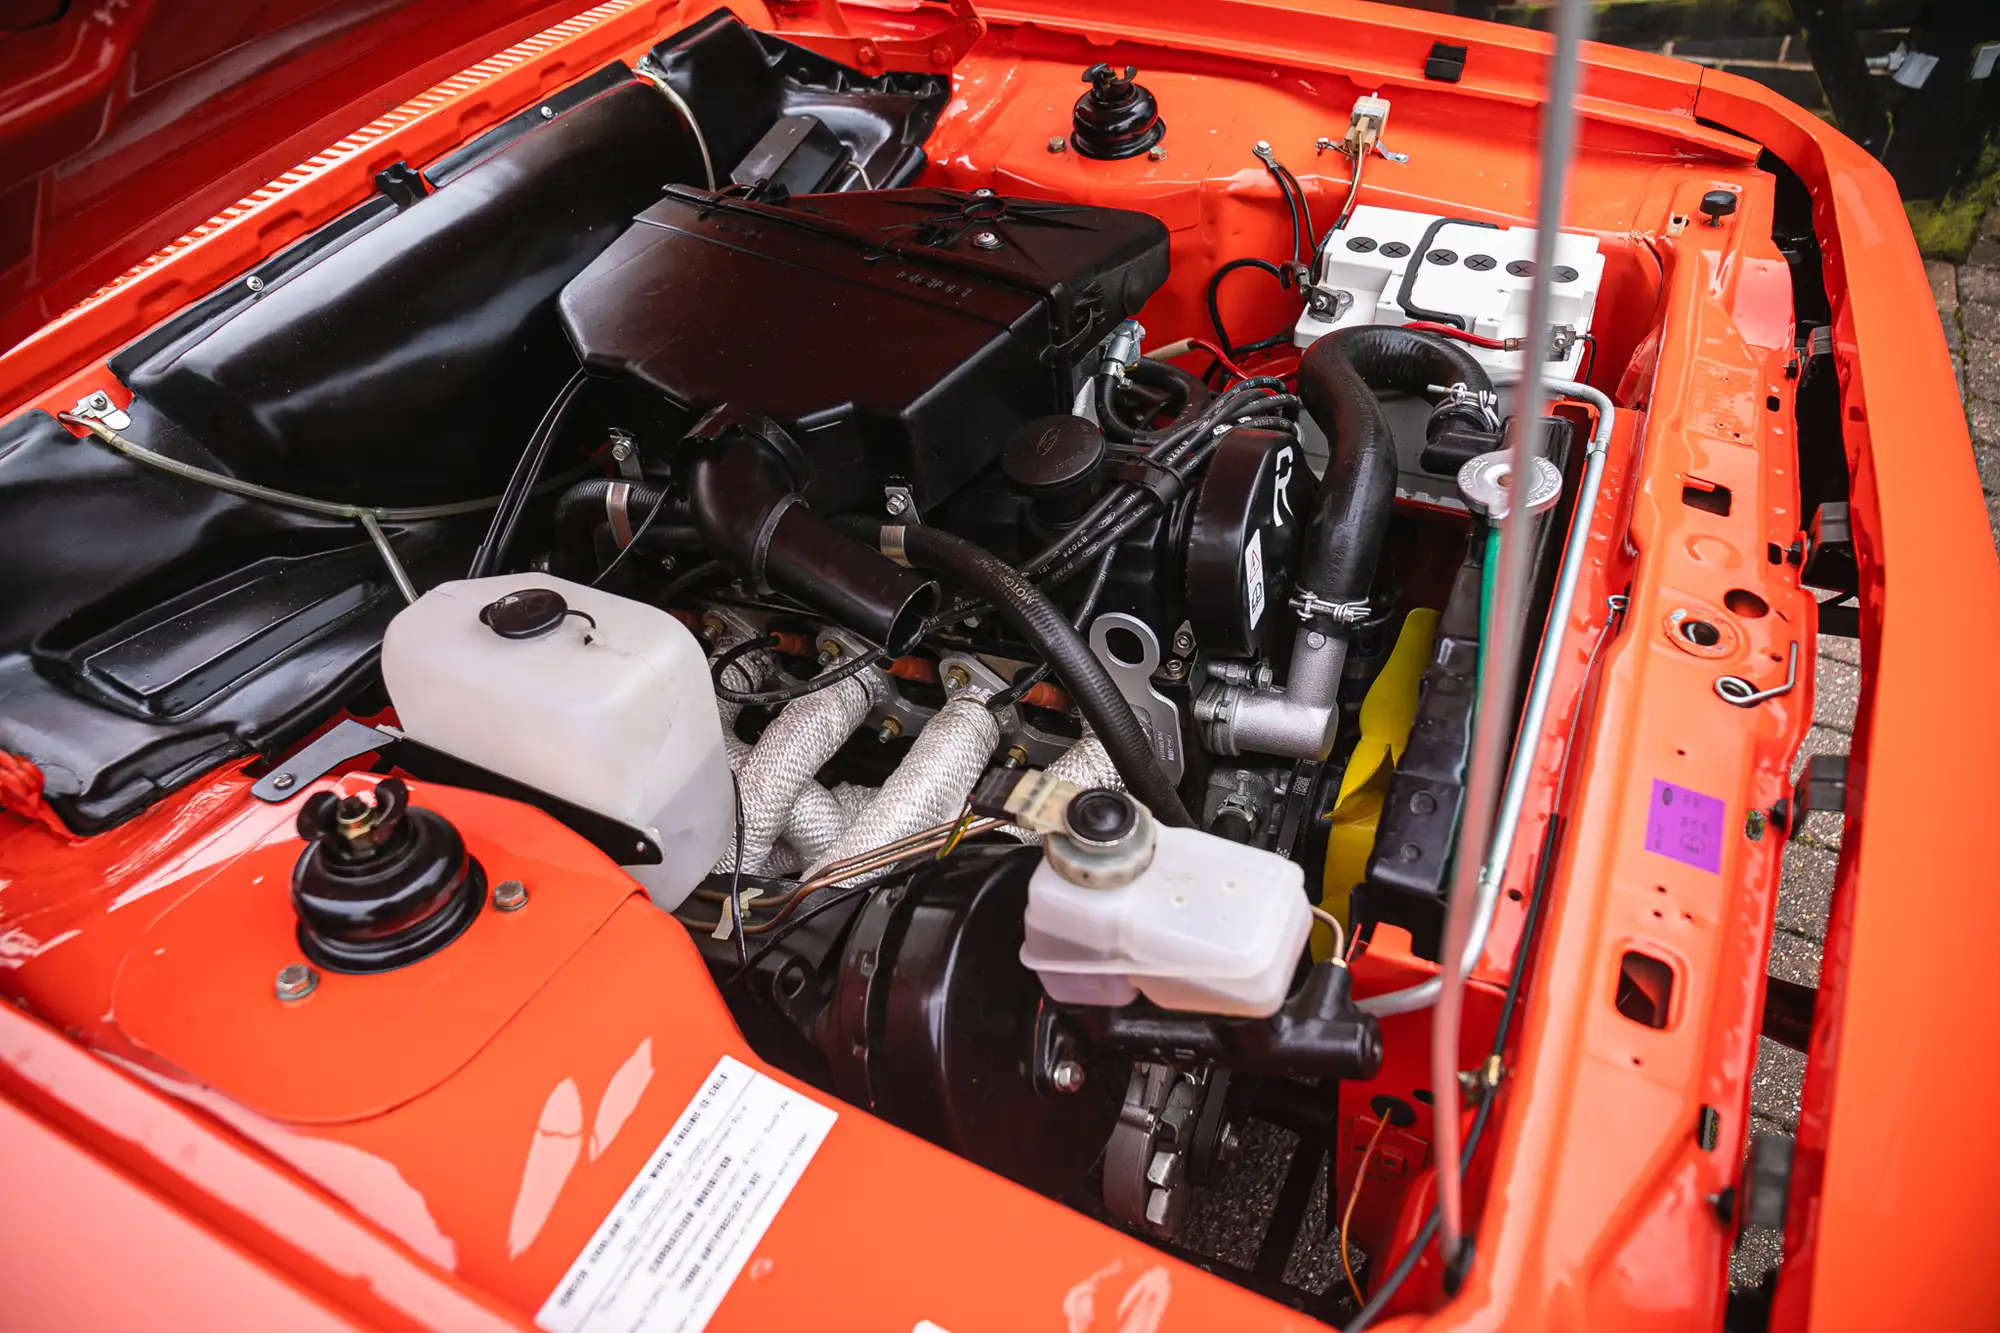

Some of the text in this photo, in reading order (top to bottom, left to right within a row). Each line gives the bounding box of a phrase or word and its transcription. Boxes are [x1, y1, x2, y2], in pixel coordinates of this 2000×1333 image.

[1123, 493, 1136, 506] HE
[1098, 512, 1116, 529] Ford
[1111, 522, 1125, 534] HE
[1062, 535, 1088, 558] B7028
[837, 660, 866, 679] B7028
[779, 691, 791, 700] HE
